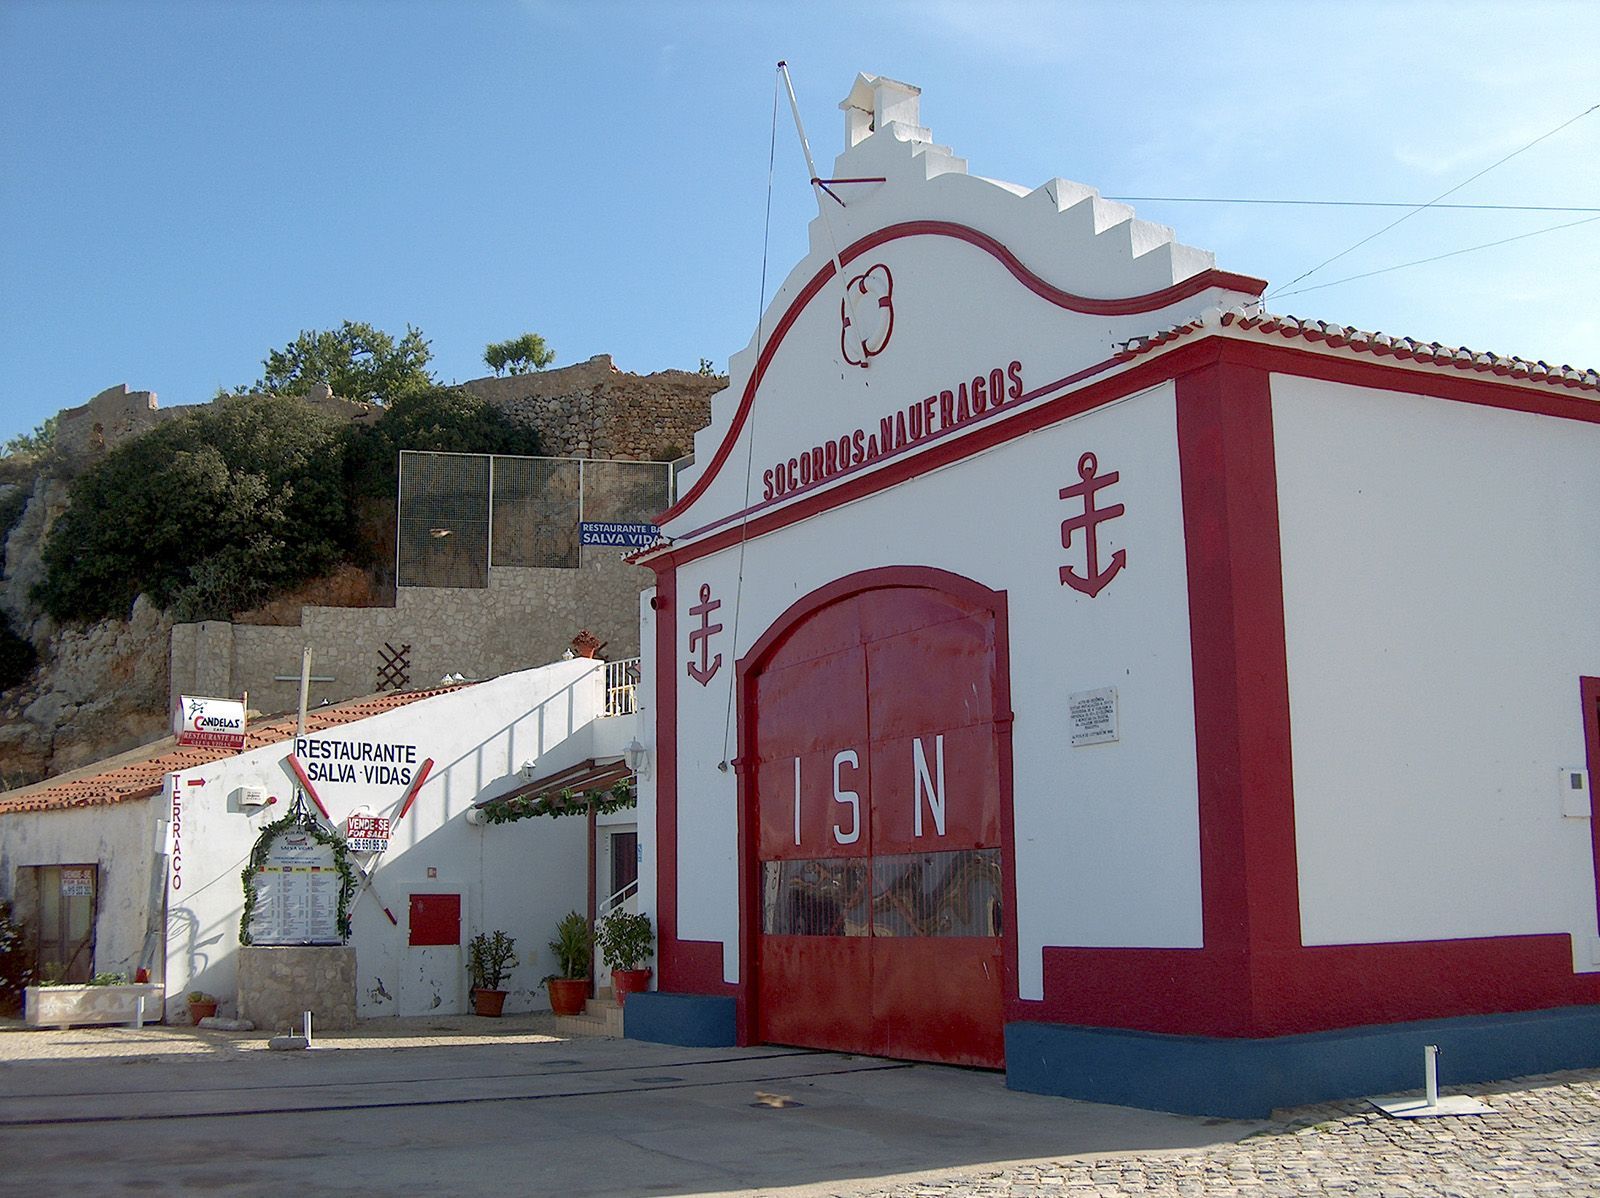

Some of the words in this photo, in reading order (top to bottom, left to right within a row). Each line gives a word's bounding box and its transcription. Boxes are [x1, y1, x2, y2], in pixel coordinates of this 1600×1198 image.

[763, 429, 865, 500] SOCORROS
[880, 361, 1022, 452] NAUFRAGOS
[583, 523, 646, 533] RESTAURANTE
[651, 525, 660, 533] BA
[583, 533, 625, 543] SALVA
[194, 716, 240, 730] CANDELAS
[184, 732, 229, 741] RESTAURANTE
[296, 739, 416, 763] RESTAURANTE
[348, 818, 389, 830] VENDE-SE
[367, 830, 389, 838] SALE
